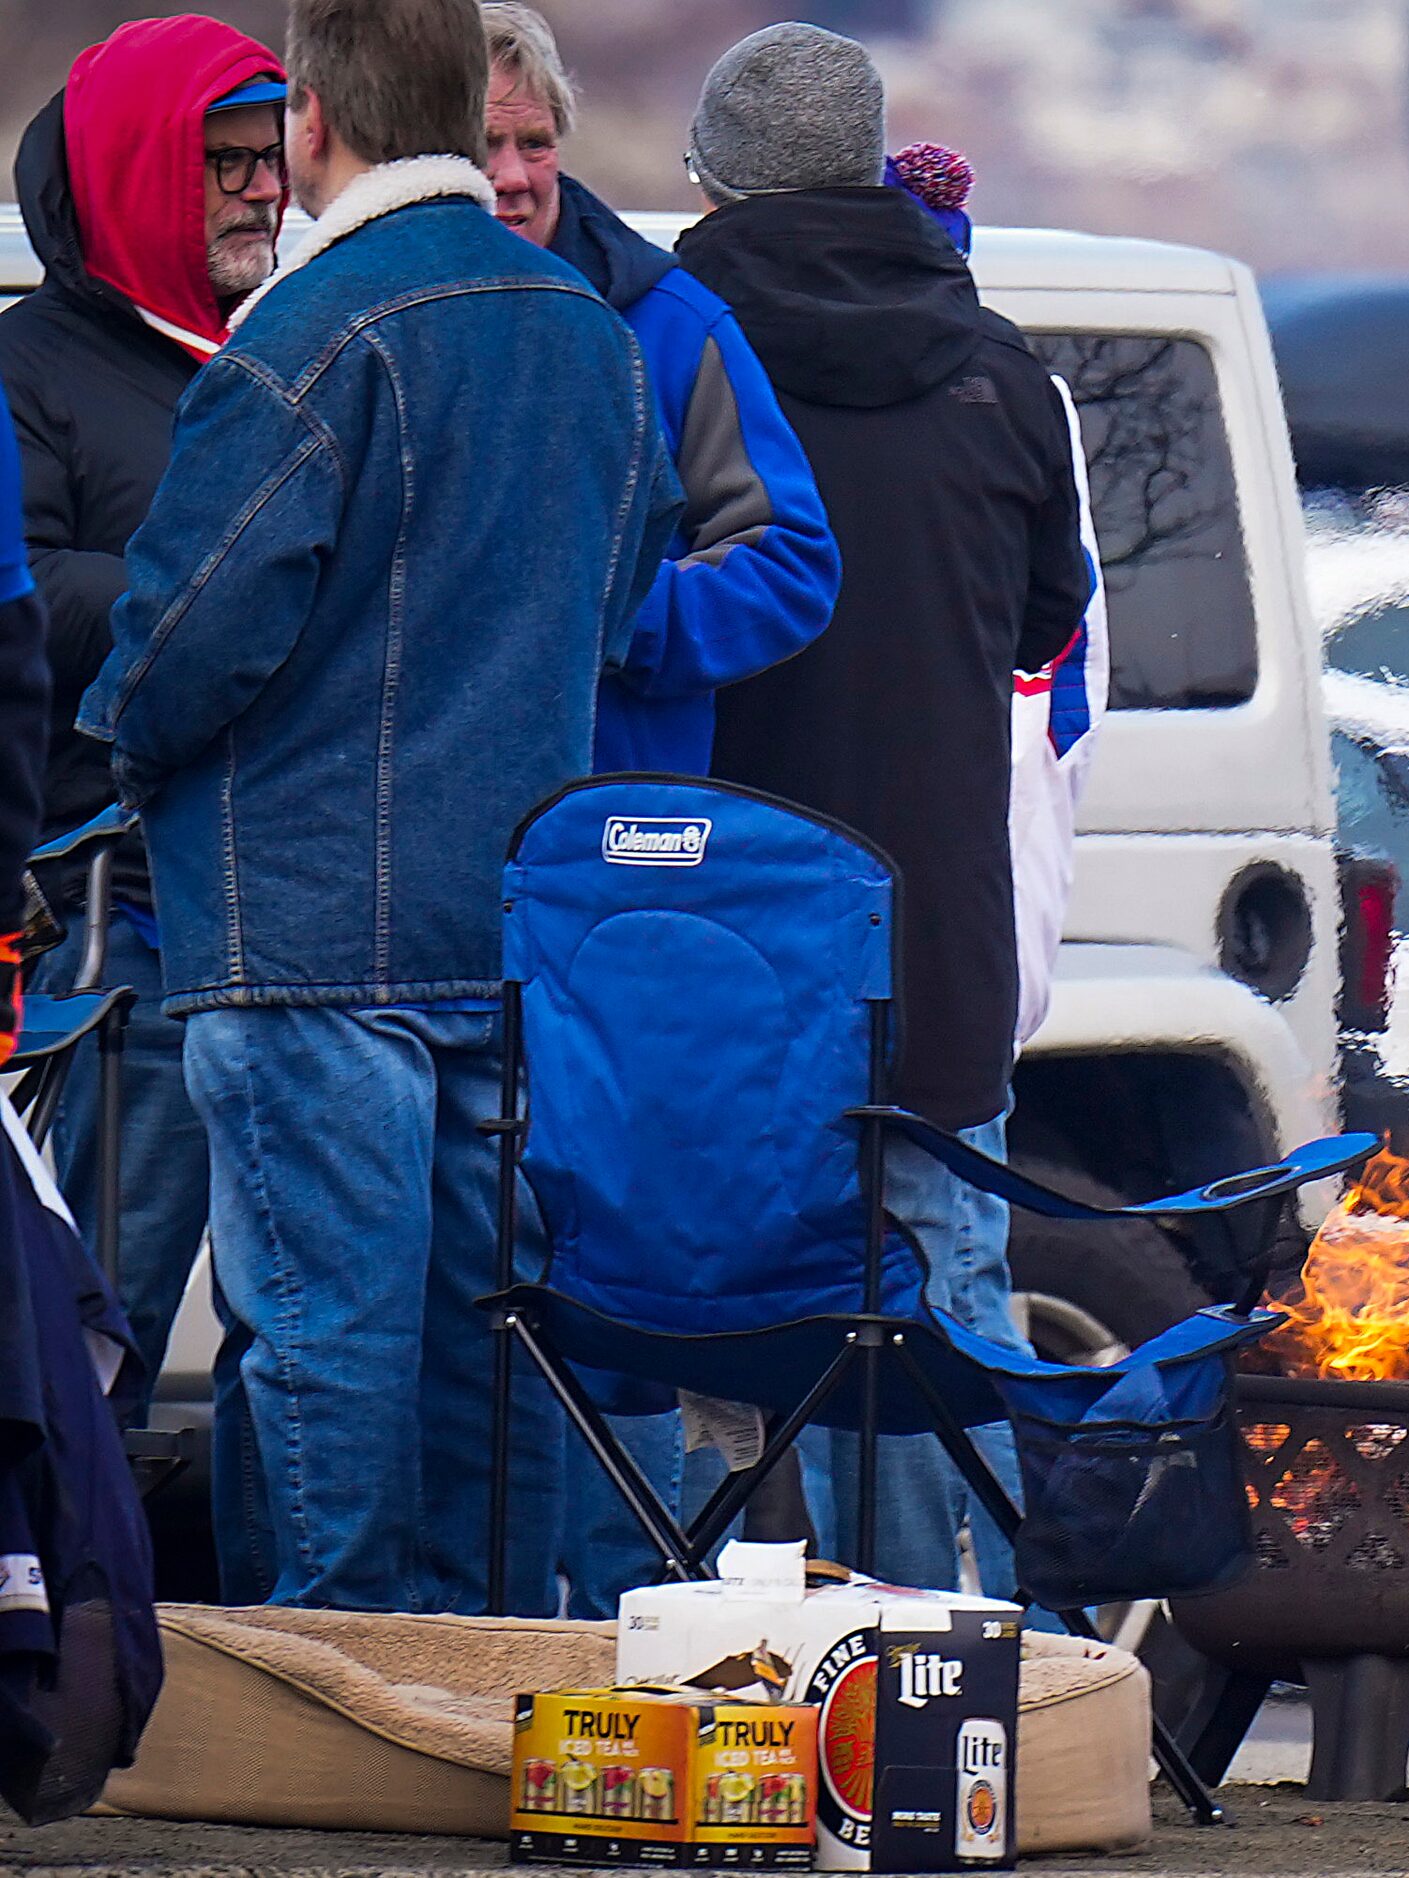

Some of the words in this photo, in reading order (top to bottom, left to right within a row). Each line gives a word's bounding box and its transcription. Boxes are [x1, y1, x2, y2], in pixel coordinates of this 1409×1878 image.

[608, 822, 683, 852] Coleman
[982, 1621, 1001, 1638] 30
[812, 1634, 867, 1694] FINE
[897, 1652, 962, 1708] Lite
[563, 1709, 641, 1740] TRULY
[717, 1720, 795, 1746] TRULY
[962, 1735, 1002, 1775] Lite
